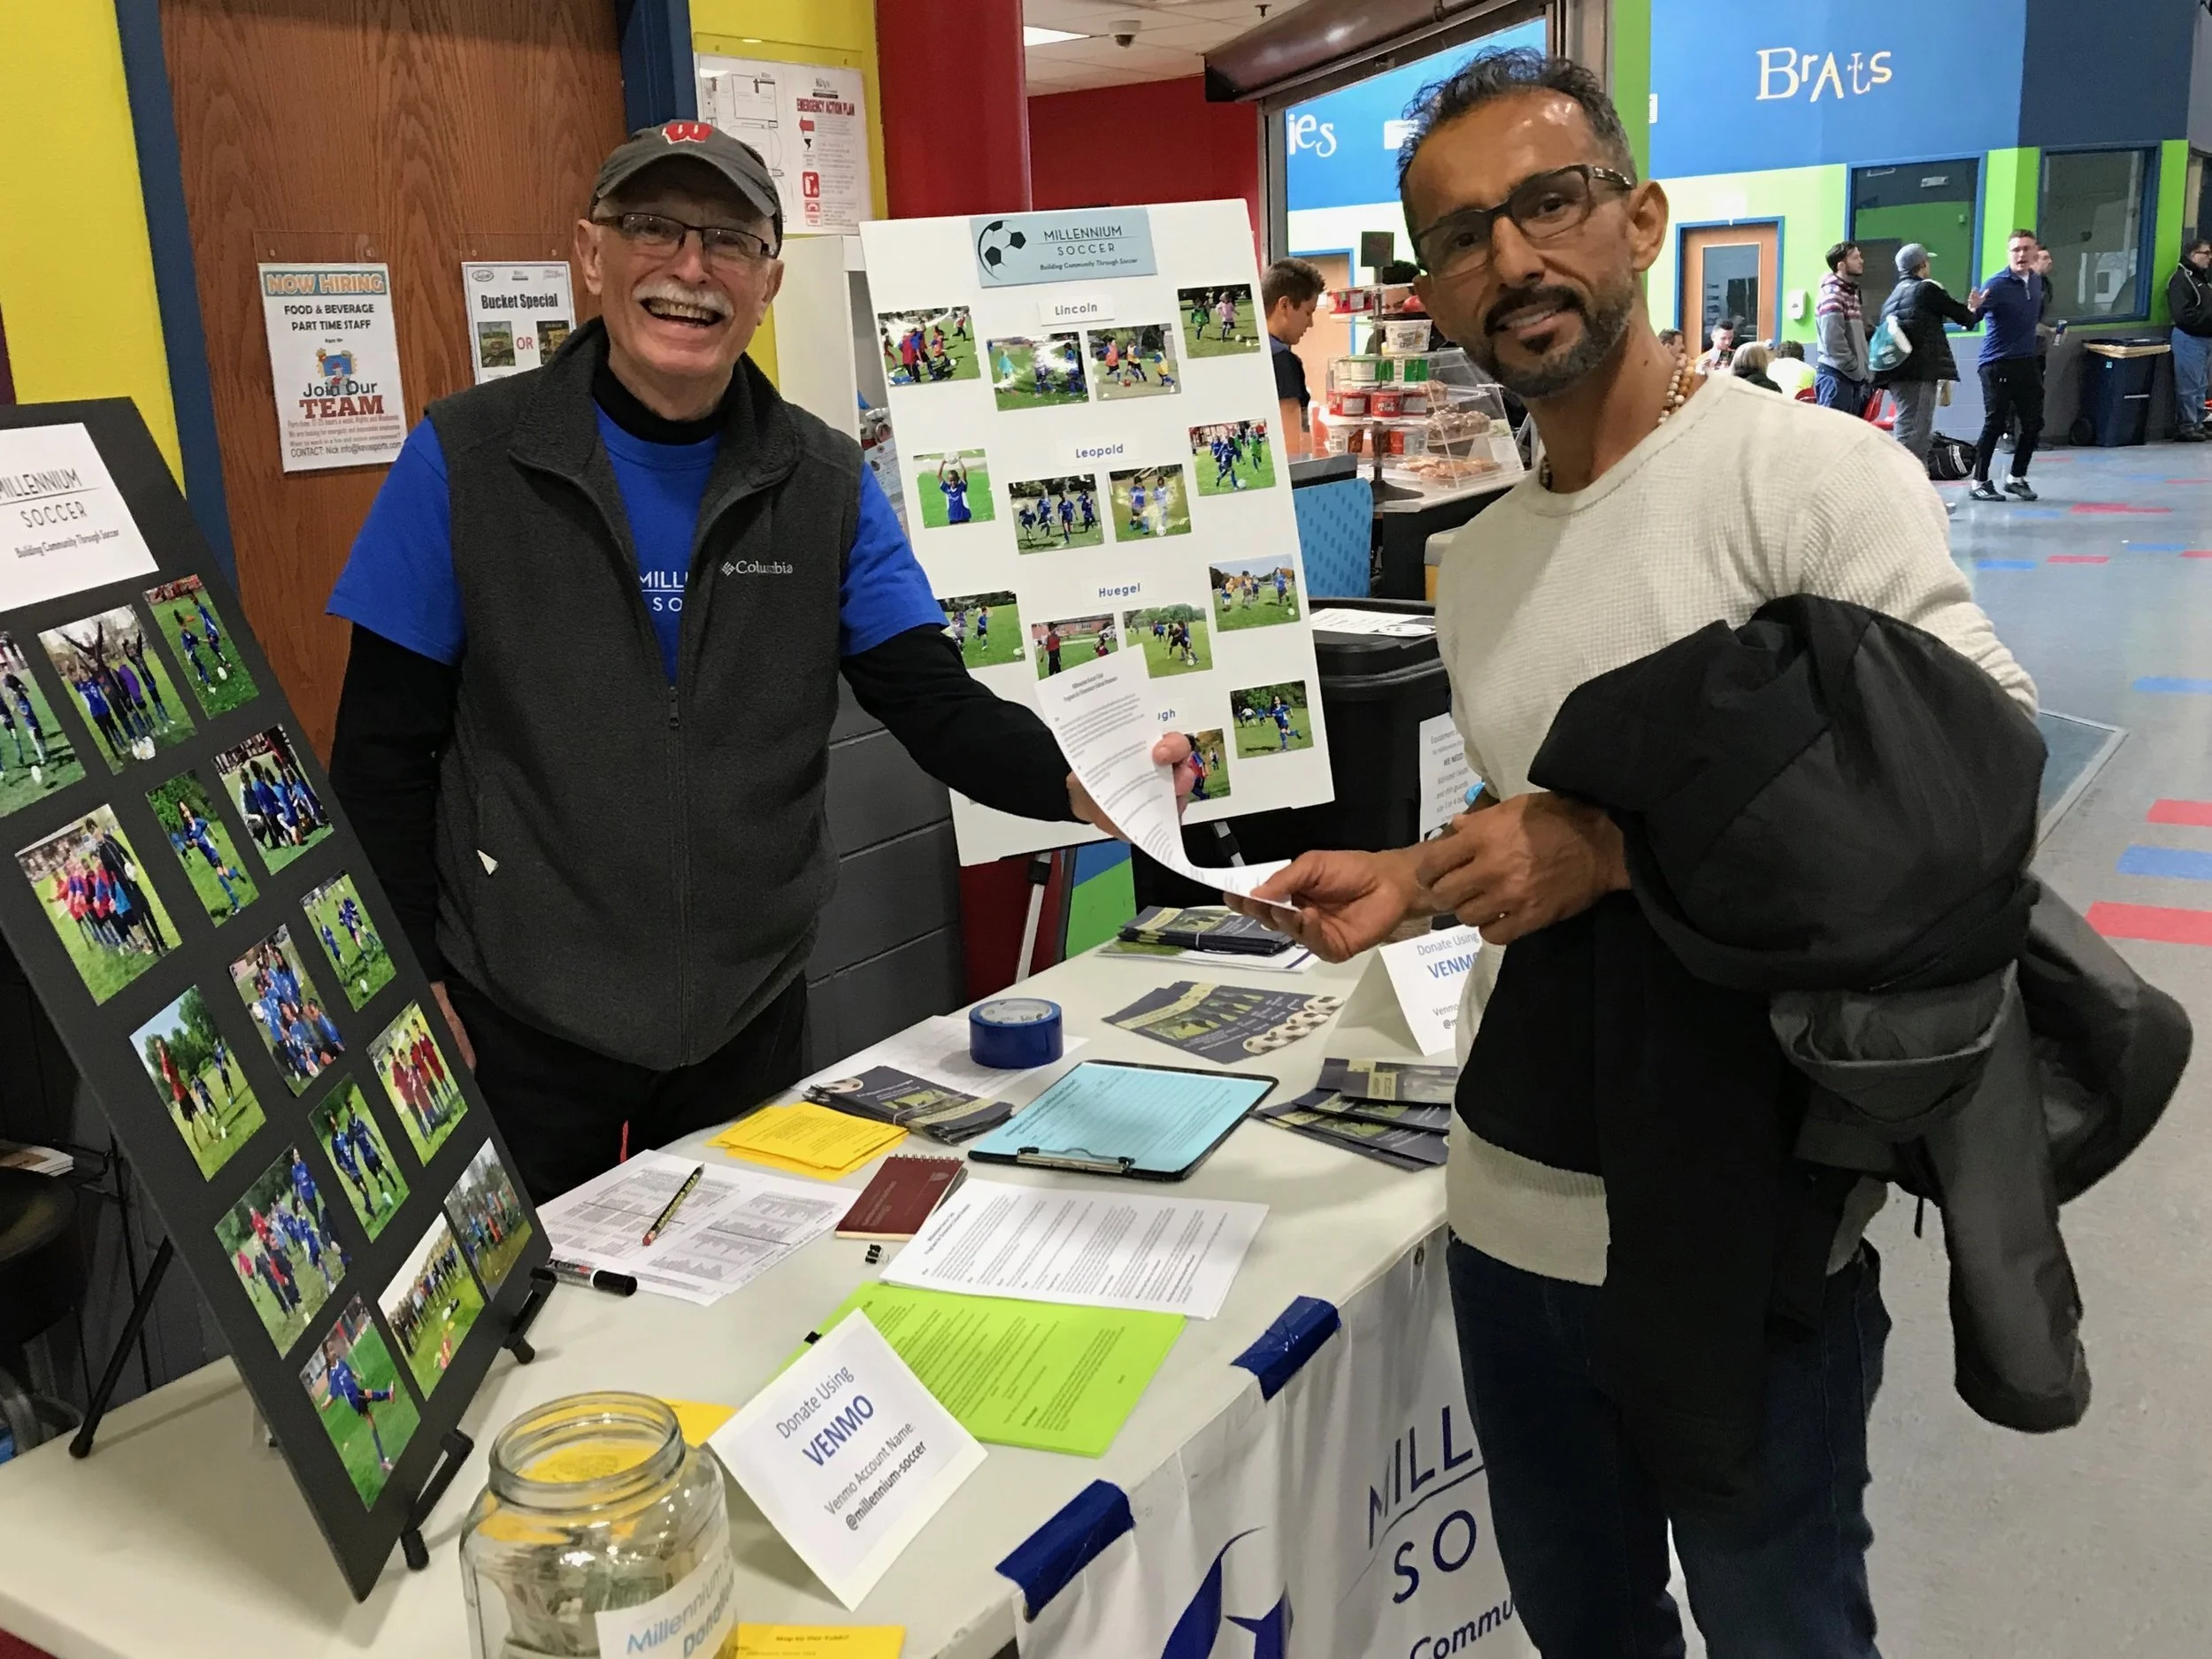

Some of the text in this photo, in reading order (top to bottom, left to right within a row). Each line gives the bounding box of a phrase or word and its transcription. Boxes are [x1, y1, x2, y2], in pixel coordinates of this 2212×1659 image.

[1043, 226, 1123, 242] MILLENNIUM
[1057, 242, 1116, 256] SOCCER
[266, 273, 385, 295] NOW HIRING
[284, 303, 374, 315] FOOD & BEVERAGE
[480, 293, 558, 310] Bucket Special
[1055, 303, 1098, 316] Lincoln
[291, 319, 372, 331] PART TIME STAFF
[516, 336, 534, 350] OR
[303, 380, 378, 397] Join Our
[299, 395, 384, 419] TEAM
[1075, 443, 1124, 458] Leopold
[19, 501, 88, 528] SOCCER
[14, 544, 45, 558] Building
[42, 536, 78, 552] Community
[99, 529, 119, 540] Soccer
[735, 560, 794, 574] Columbia
[639, 571, 688, 588] MILL
[1098, 582, 1141, 598] Huegel
[1417, 932, 1479, 956] Donate Using
[775, 1365, 855, 1440] Donate Using
[802, 1394, 874, 1467] VENMO
[823, 1421, 917, 1516] Venmo Account Name:
[845, 1440, 927, 1532] @millennium-soccer
